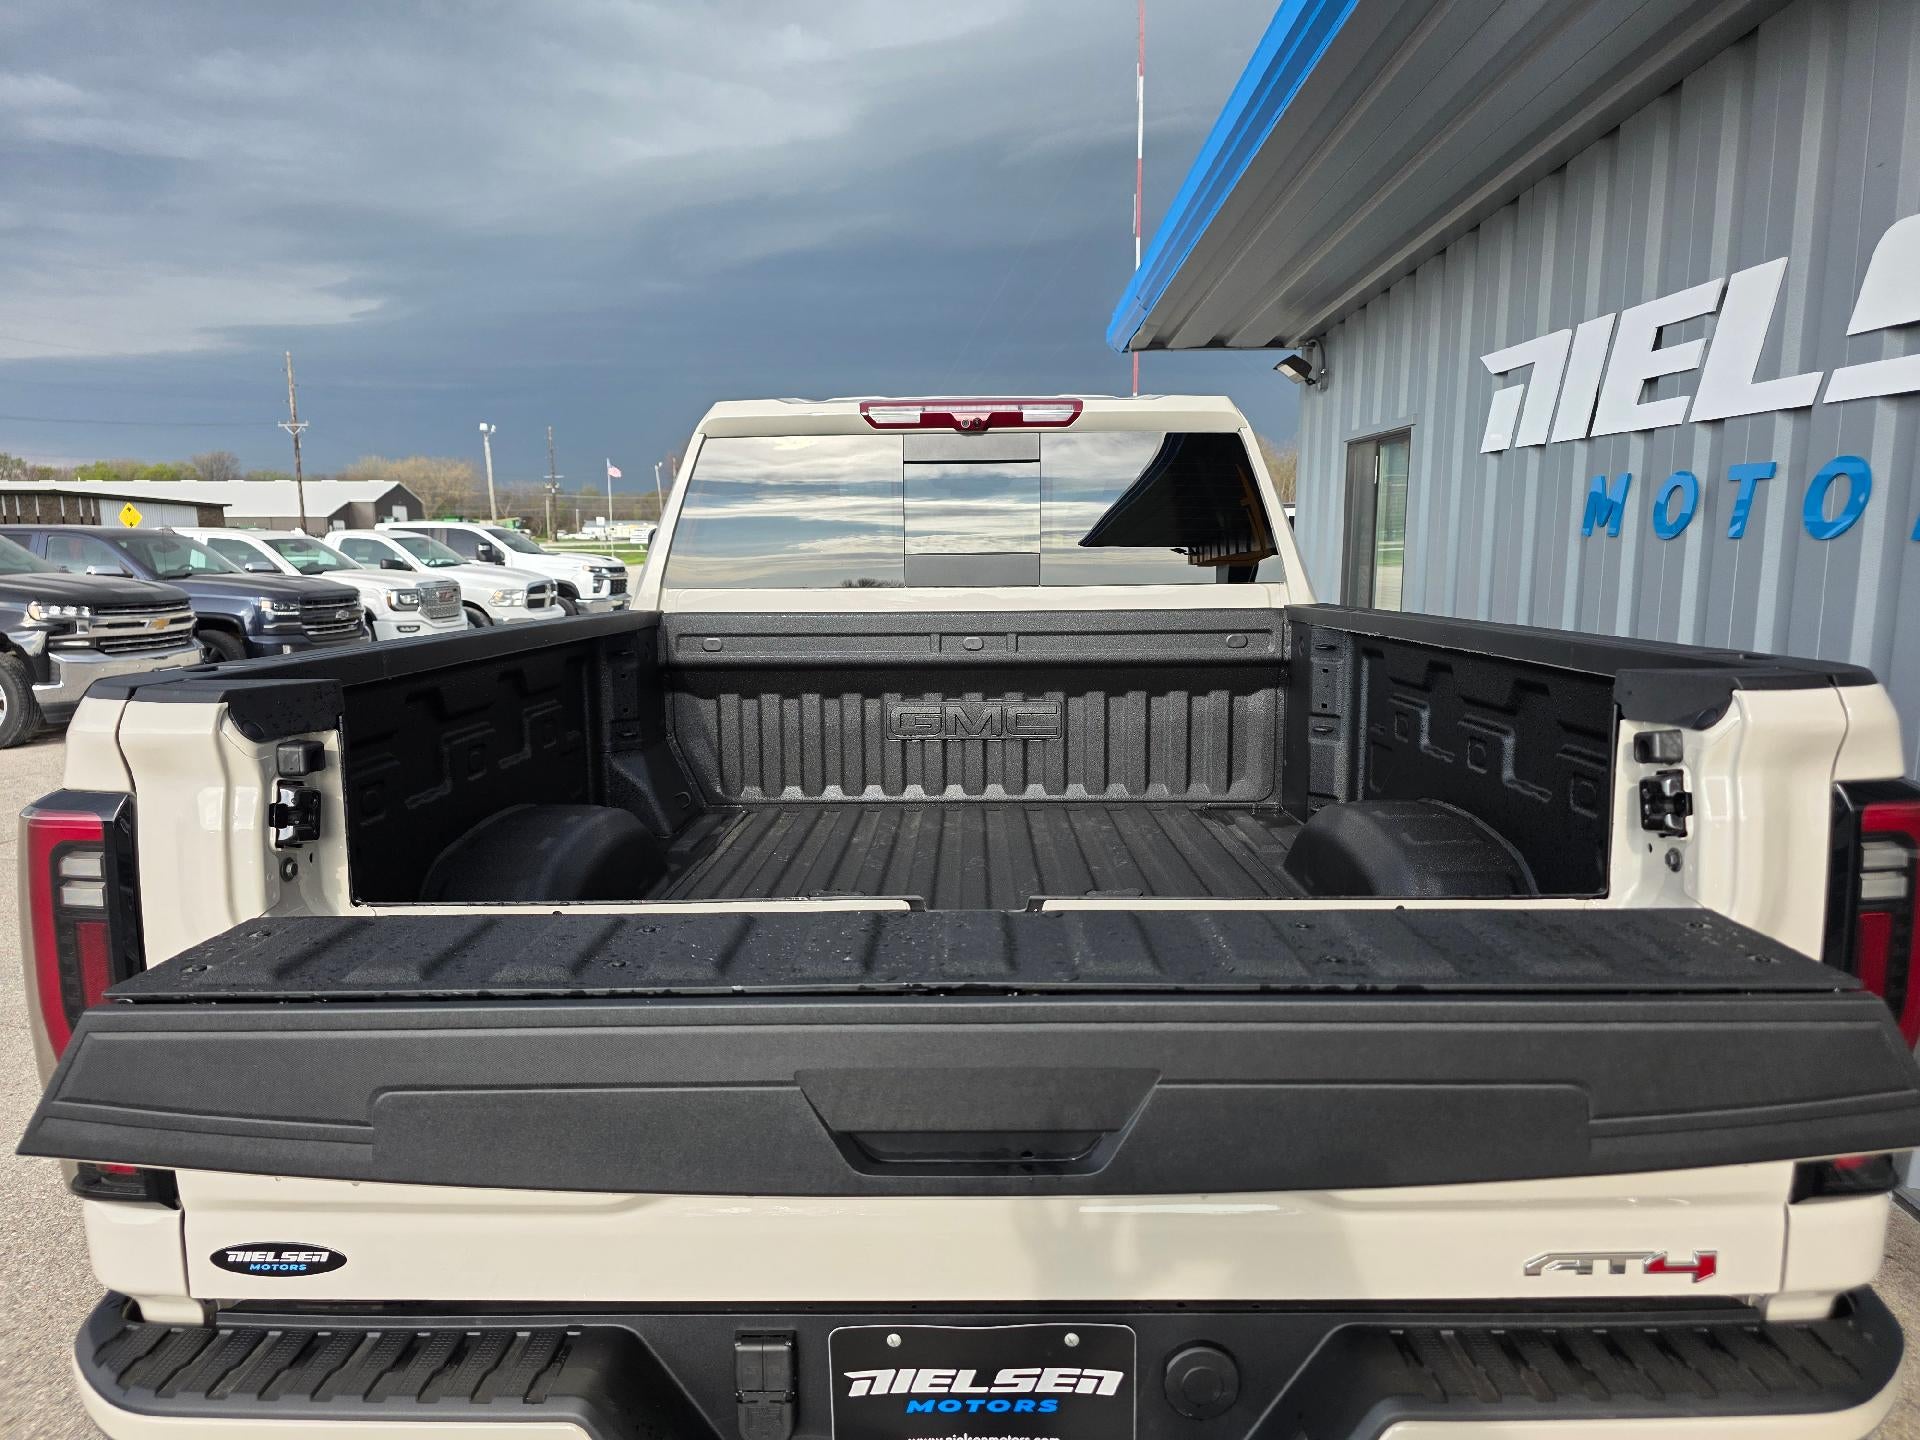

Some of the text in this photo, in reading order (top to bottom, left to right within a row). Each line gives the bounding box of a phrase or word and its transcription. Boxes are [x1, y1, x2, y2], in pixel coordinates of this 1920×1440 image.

[1581, 455, 1920, 541] MOTO
[889, 705, 1058, 736] GMC
[226, 1251, 330, 1262] NIELSEN
[249, 1263, 307, 1271] MOTORS
[1524, 1250, 1717, 1283] AT4
[843, 1367, 1124, 1397] NIELSEN
[906, 1399, 1058, 1414] MOTORS
